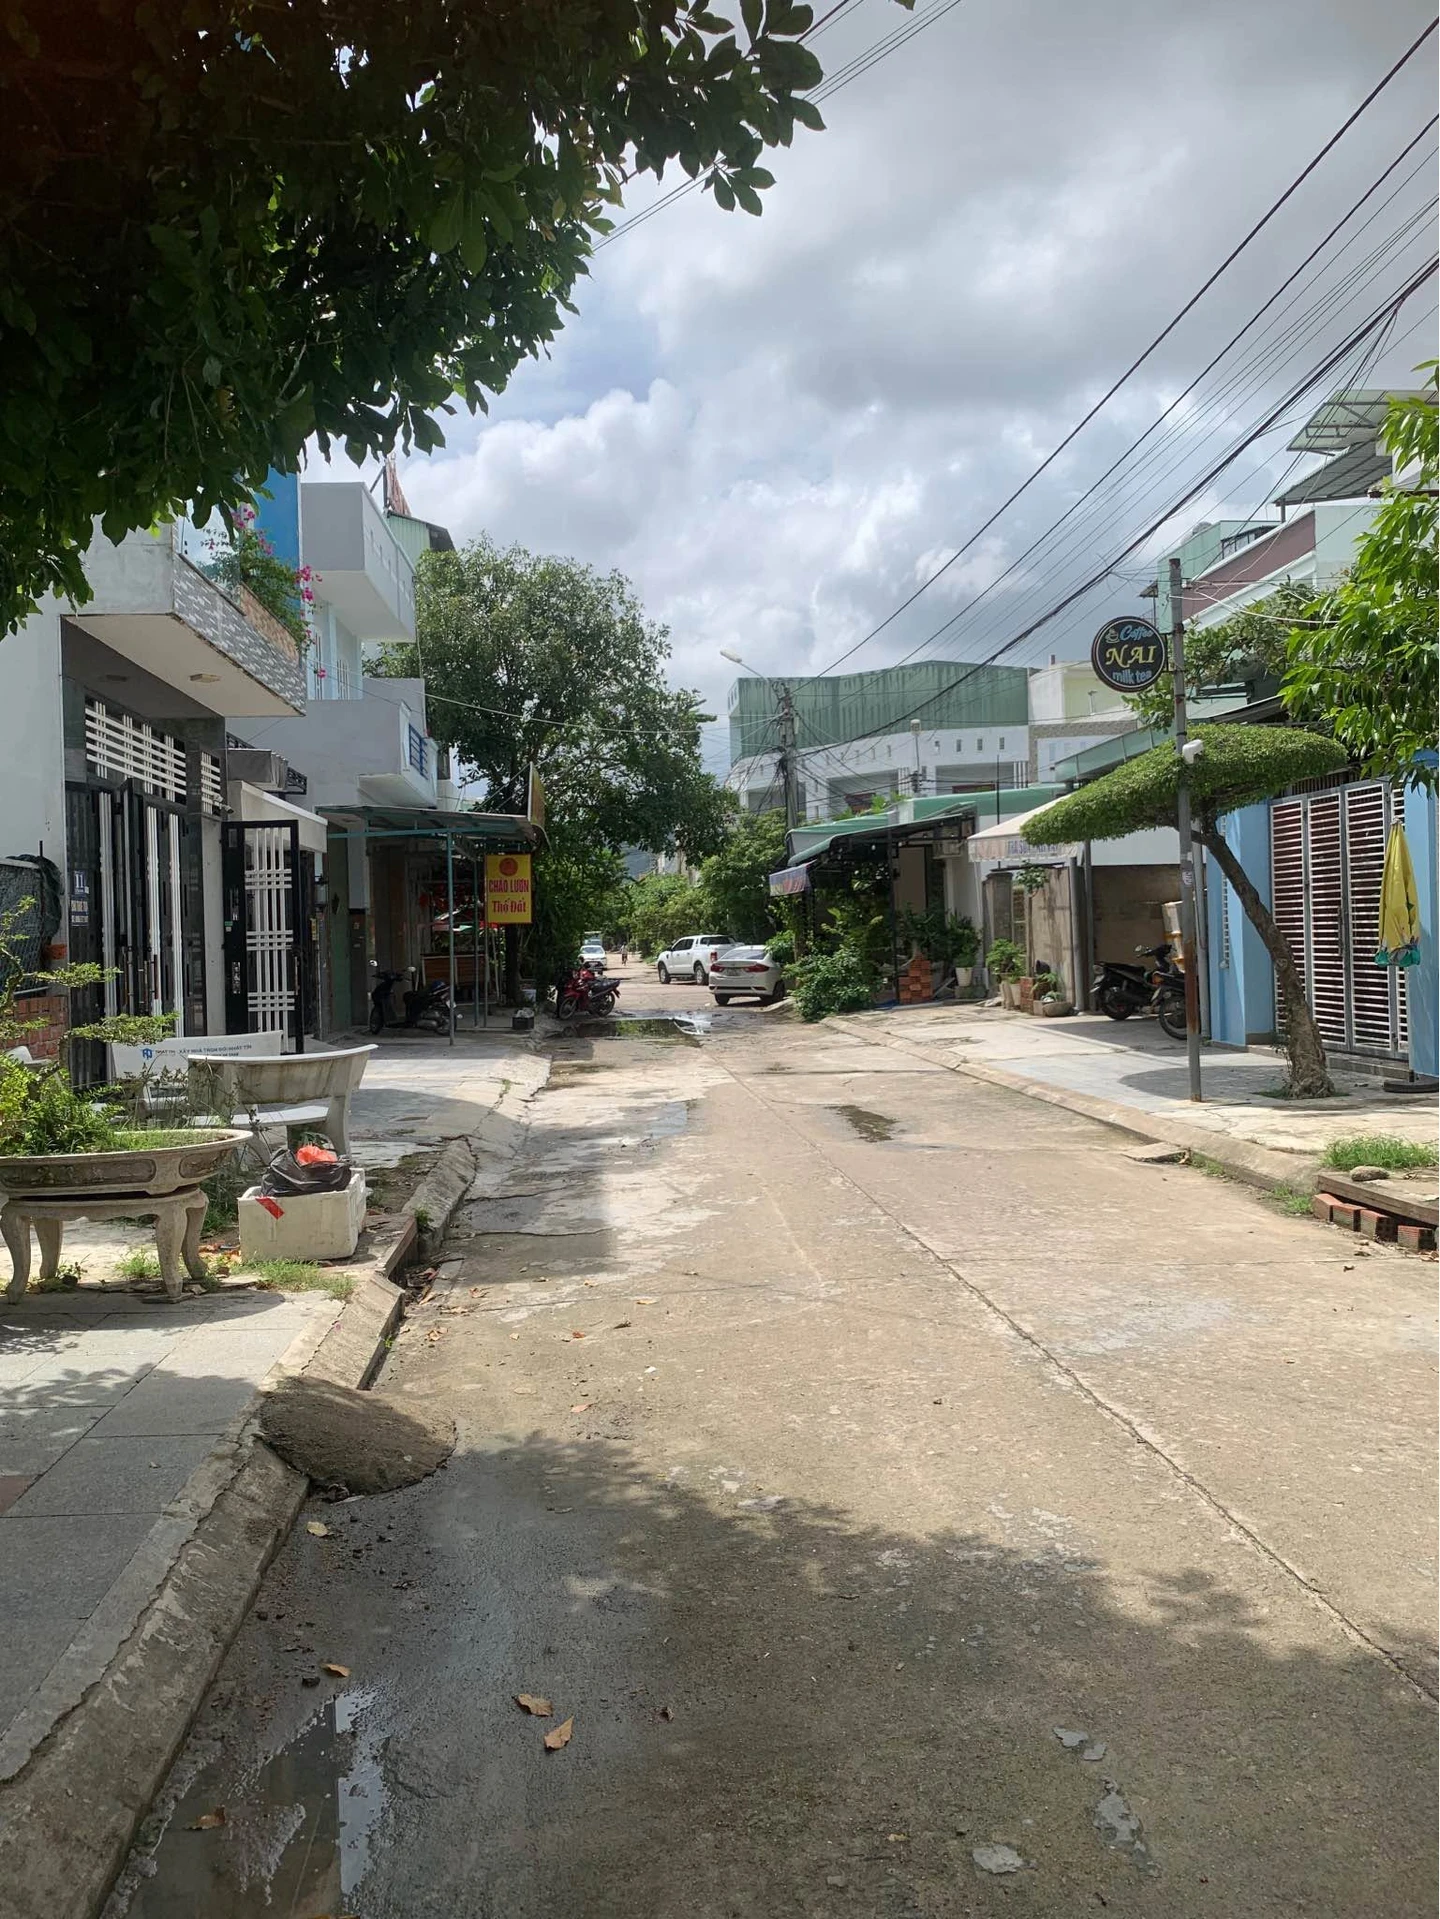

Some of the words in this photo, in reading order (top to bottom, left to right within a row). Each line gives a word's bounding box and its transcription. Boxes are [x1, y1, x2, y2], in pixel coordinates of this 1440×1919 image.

[1120, 625, 1154, 640] Coffee
[1105, 644, 1157, 668] NAI
[1112, 669, 1135, 684] milk
[1135, 670, 1153, 683] tea
[75, 873, 84, 888] 11
